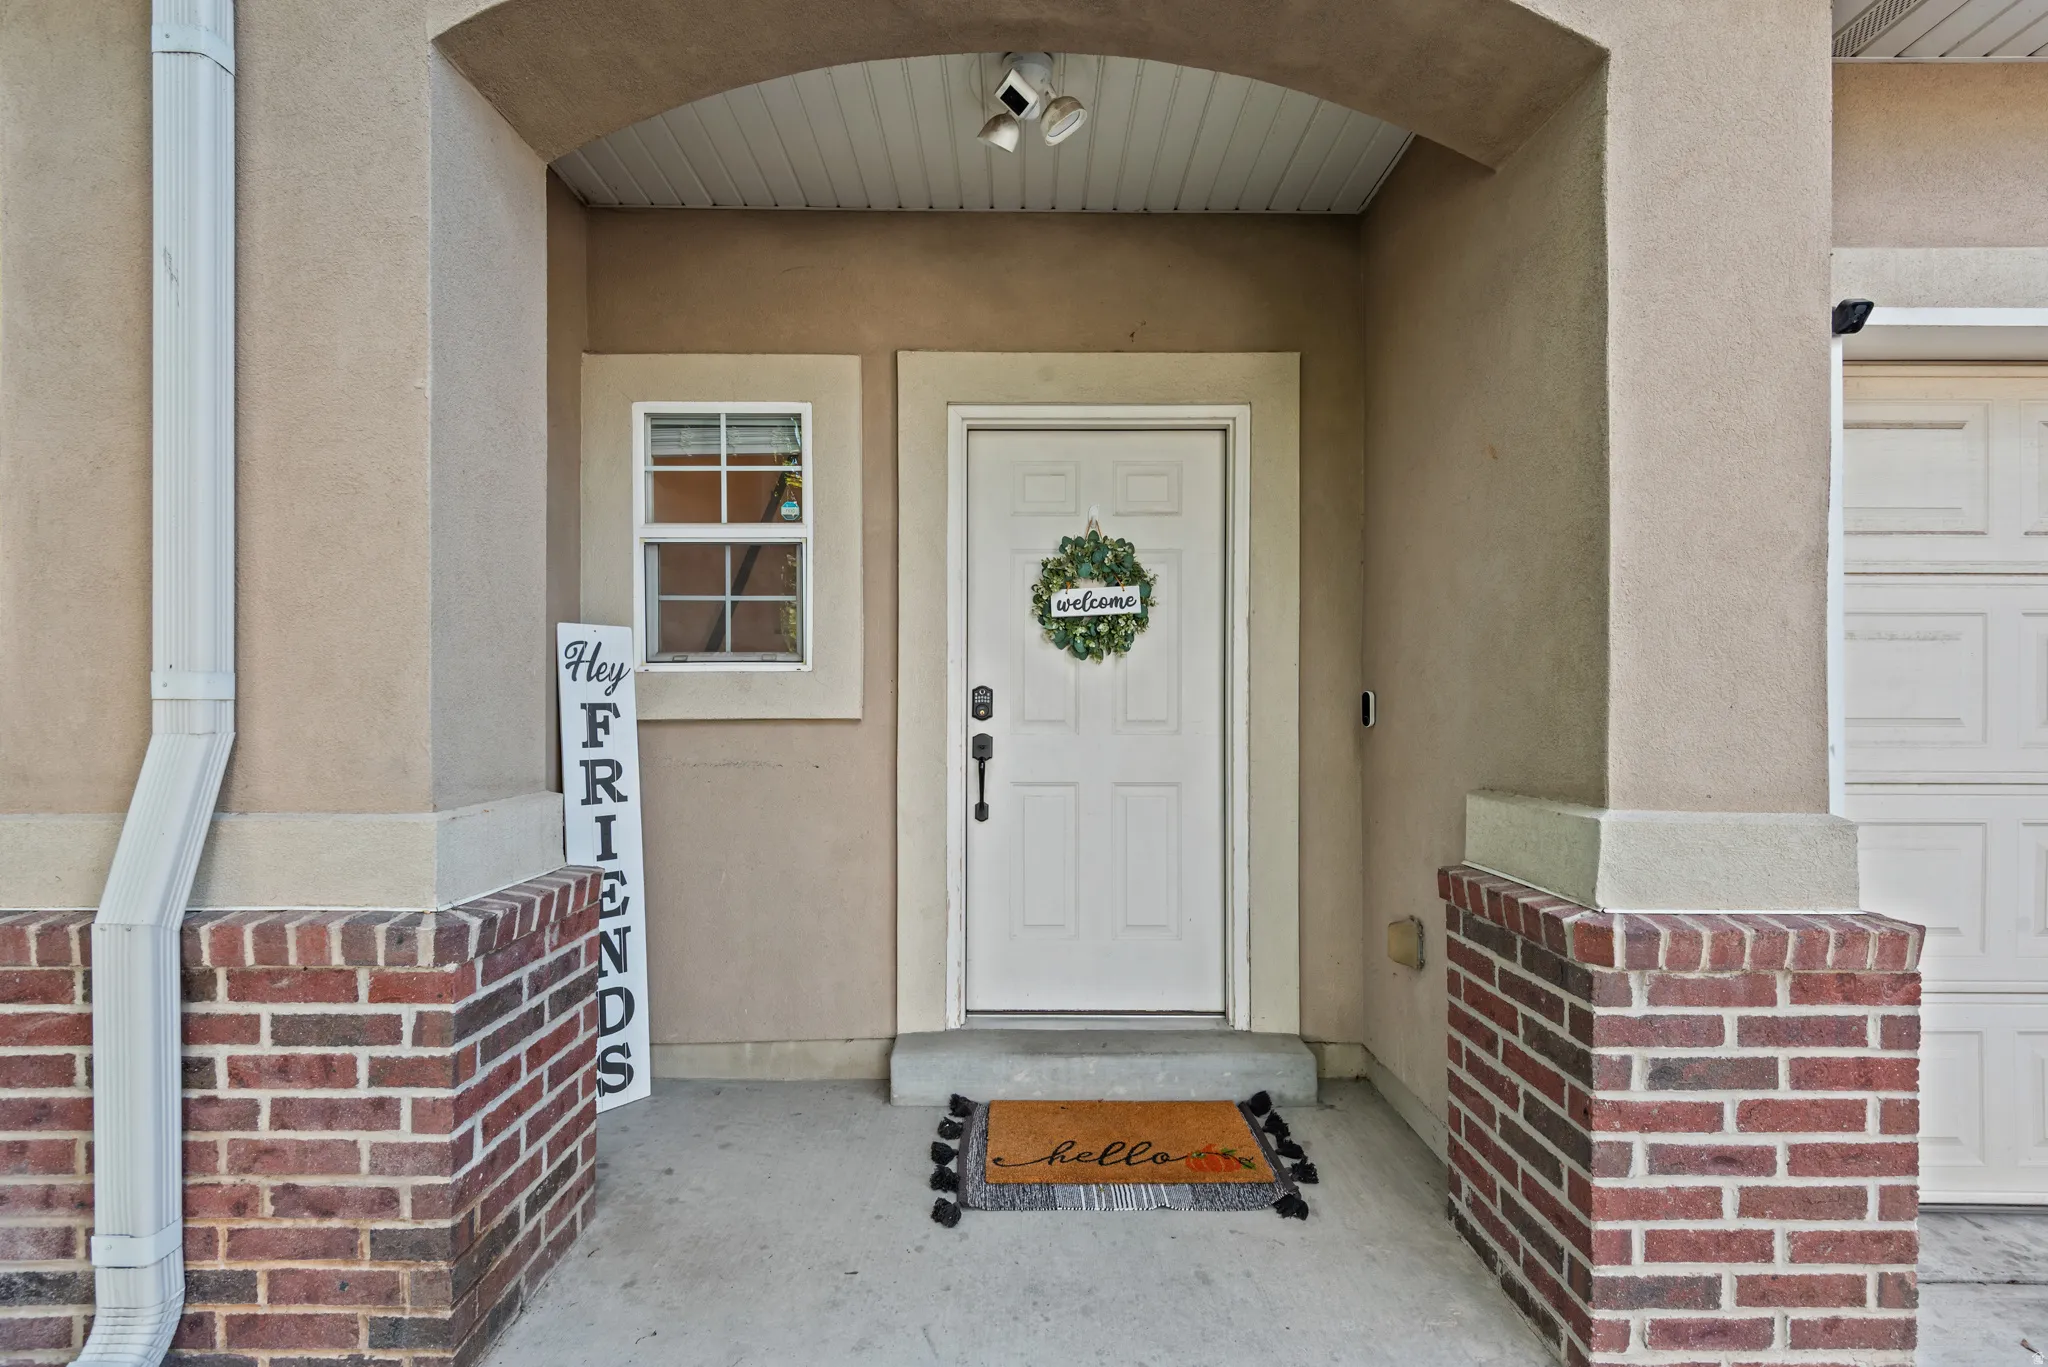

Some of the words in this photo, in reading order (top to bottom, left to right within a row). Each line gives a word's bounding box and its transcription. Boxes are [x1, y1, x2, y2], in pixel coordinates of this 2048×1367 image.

[1056, 590, 1137, 613] welcome
[564, 640, 632, 697] Hey
[579, 702, 636, 1098] FRIENDS
[993, 1139, 1187, 1168] hello
